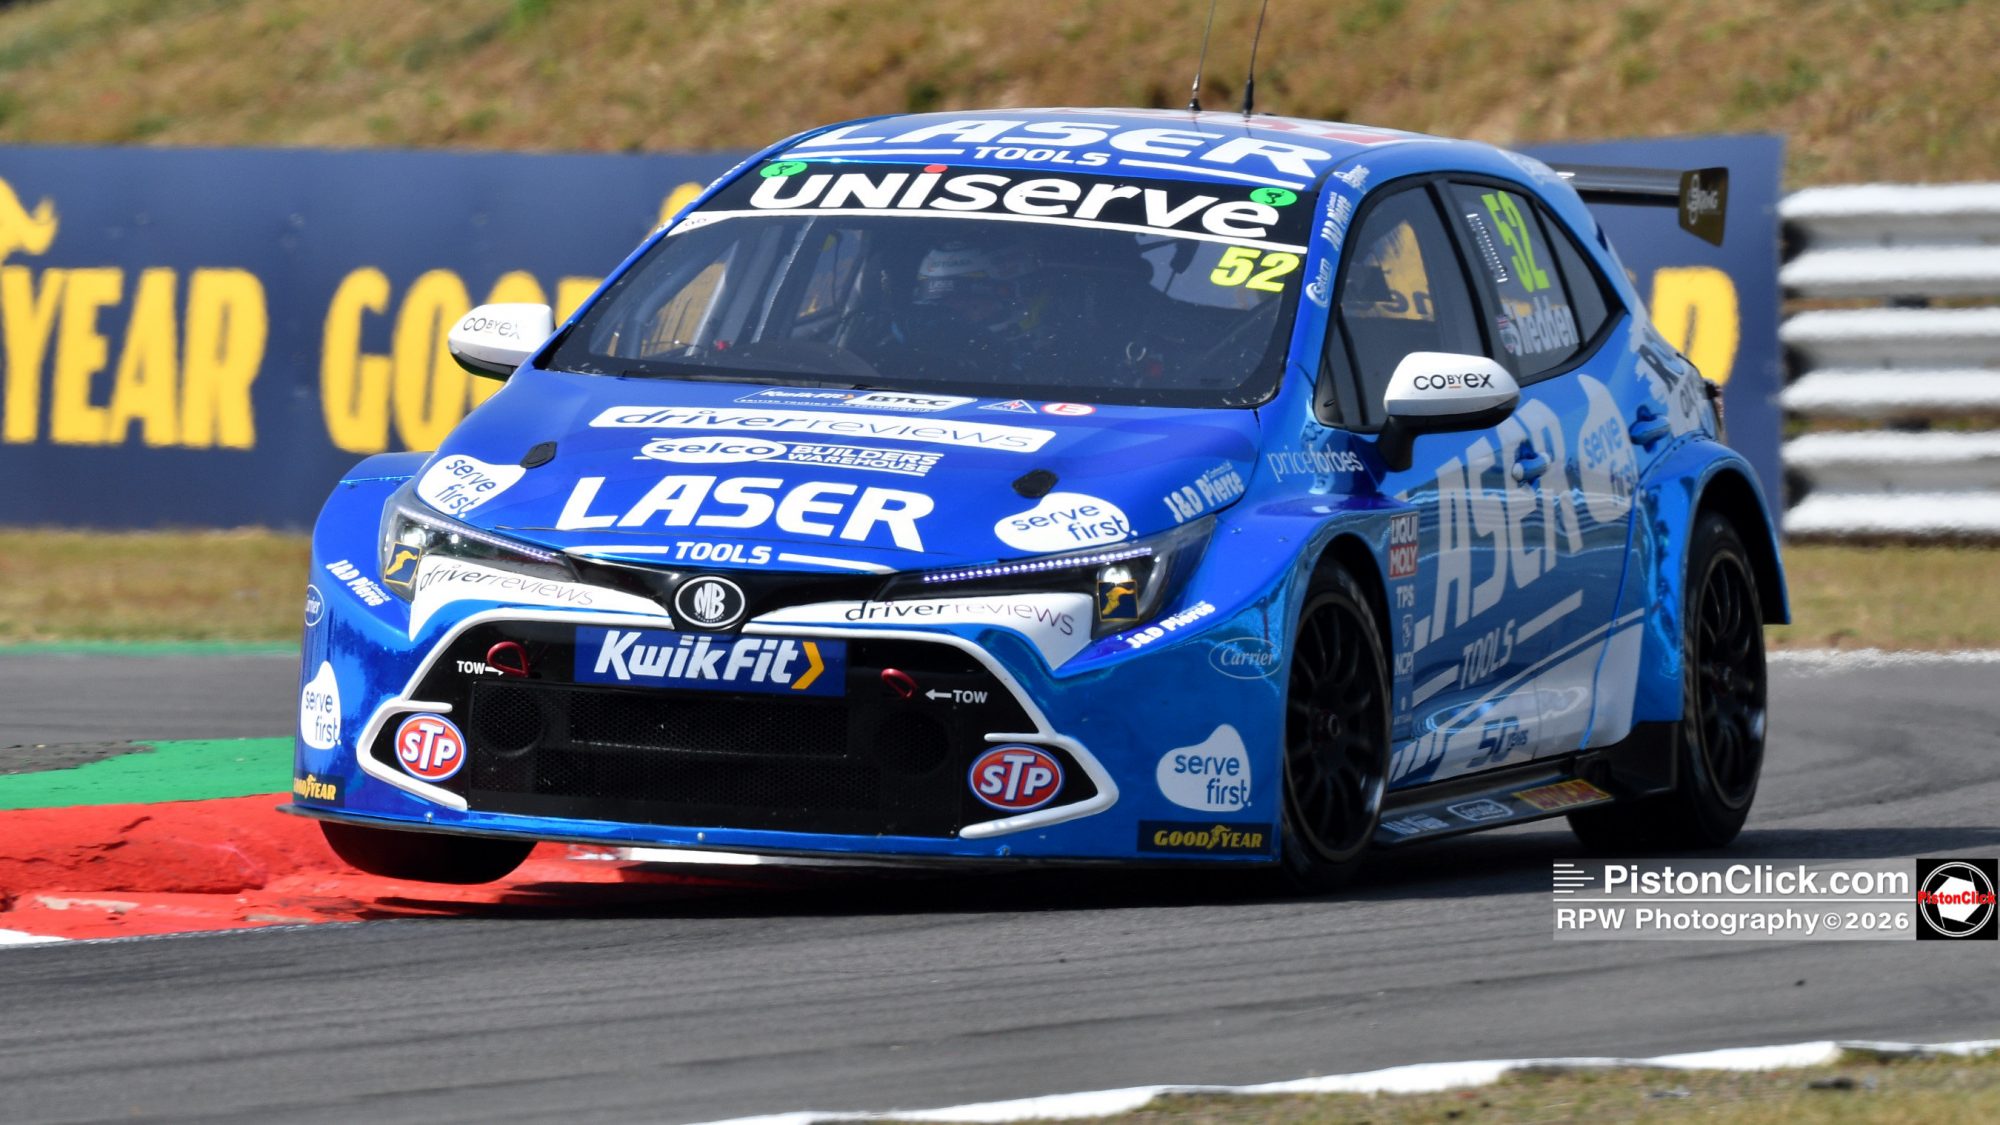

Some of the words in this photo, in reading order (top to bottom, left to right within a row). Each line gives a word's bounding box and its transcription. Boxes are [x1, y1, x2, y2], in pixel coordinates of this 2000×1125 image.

[794, 120, 1332, 178] LASER
[974, 146, 1112, 167] TOOLS
[1481, 191, 1550, 292] 52
[1210, 246, 1299, 292] 52
[1, 266, 268, 450] YEAR
[866, 395, 953, 406] BTCC
[615, 409, 1032, 449] driverreviews
[652, 440, 772, 456] selco
[792, 444, 940, 466] BUILDERS
[1267, 443, 1364, 482] priceforbes
[446, 458, 496, 492] serve
[788, 453, 932, 474] WAREHOUSE
[1163, 485, 1204, 523] J&D
[1195, 470, 1245, 507] Pierce
[556, 475, 934, 552] LASER
[1012, 503, 1100, 531] serve
[1391, 516, 1418, 544] LIQUI
[675, 541, 772, 565] TOOLS
[1390, 546, 1417, 576] MOLY
[695, 582, 725, 619] MB
[457, 661, 486, 674] TOW
[1220, 647, 1276, 669] Carrier
[1460, 619, 1516, 690] TOOLS
[305, 691, 333, 712] serve
[953, 689, 988, 703] TOW
[402, 723, 457, 770] STP
[981, 753, 1053, 800] STP
[1174, 752, 1240, 777] serve
[1153, 826, 1263, 849] GOODYEAR
